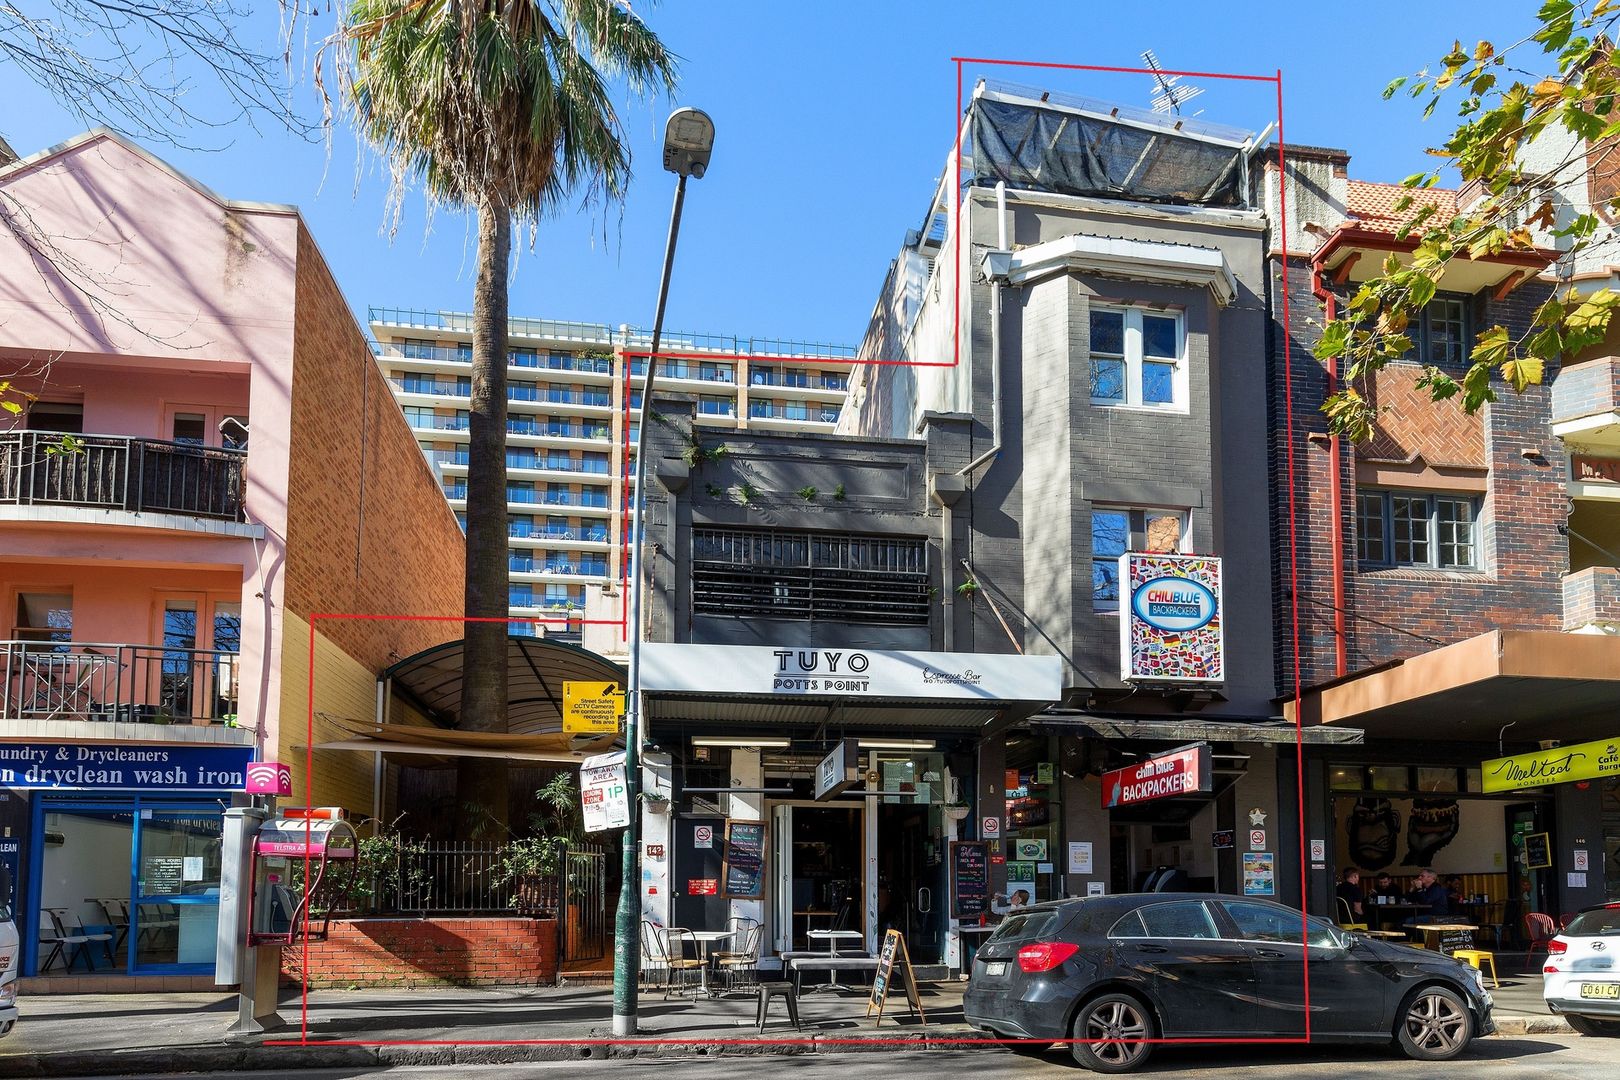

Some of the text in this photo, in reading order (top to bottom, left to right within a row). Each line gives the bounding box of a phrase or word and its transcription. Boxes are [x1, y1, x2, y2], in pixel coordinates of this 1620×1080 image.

[1148, 589, 1200, 603] CHILIBLUE
[1152, 604, 1198, 616] BACKPACKERS
[774, 651, 869, 672] TUYO
[923, 667, 982, 680] Espresso Bar
[774, 679, 869, 691] POTTS POINT
[55, 747, 69, 760] &
[77, 747, 169, 764] Drycleaners
[1598, 754, 1619, 764] Café
[1155, 761, 1174, 775] blue
[1492, 753, 1586, 780] Melted
[25, 765, 123, 787] dryclean
[134, 767, 188, 784] wash
[198, 767, 243, 784] iron
[593, 772, 613, 781] AREA
[1517, 778, 1556, 786] MONSTER
[584, 788, 603, 797] LOADING
[608, 786, 623, 798] 1P
[1123, 771, 1193, 802] BACKPACKERS
[586, 796, 601, 804] ZONE
